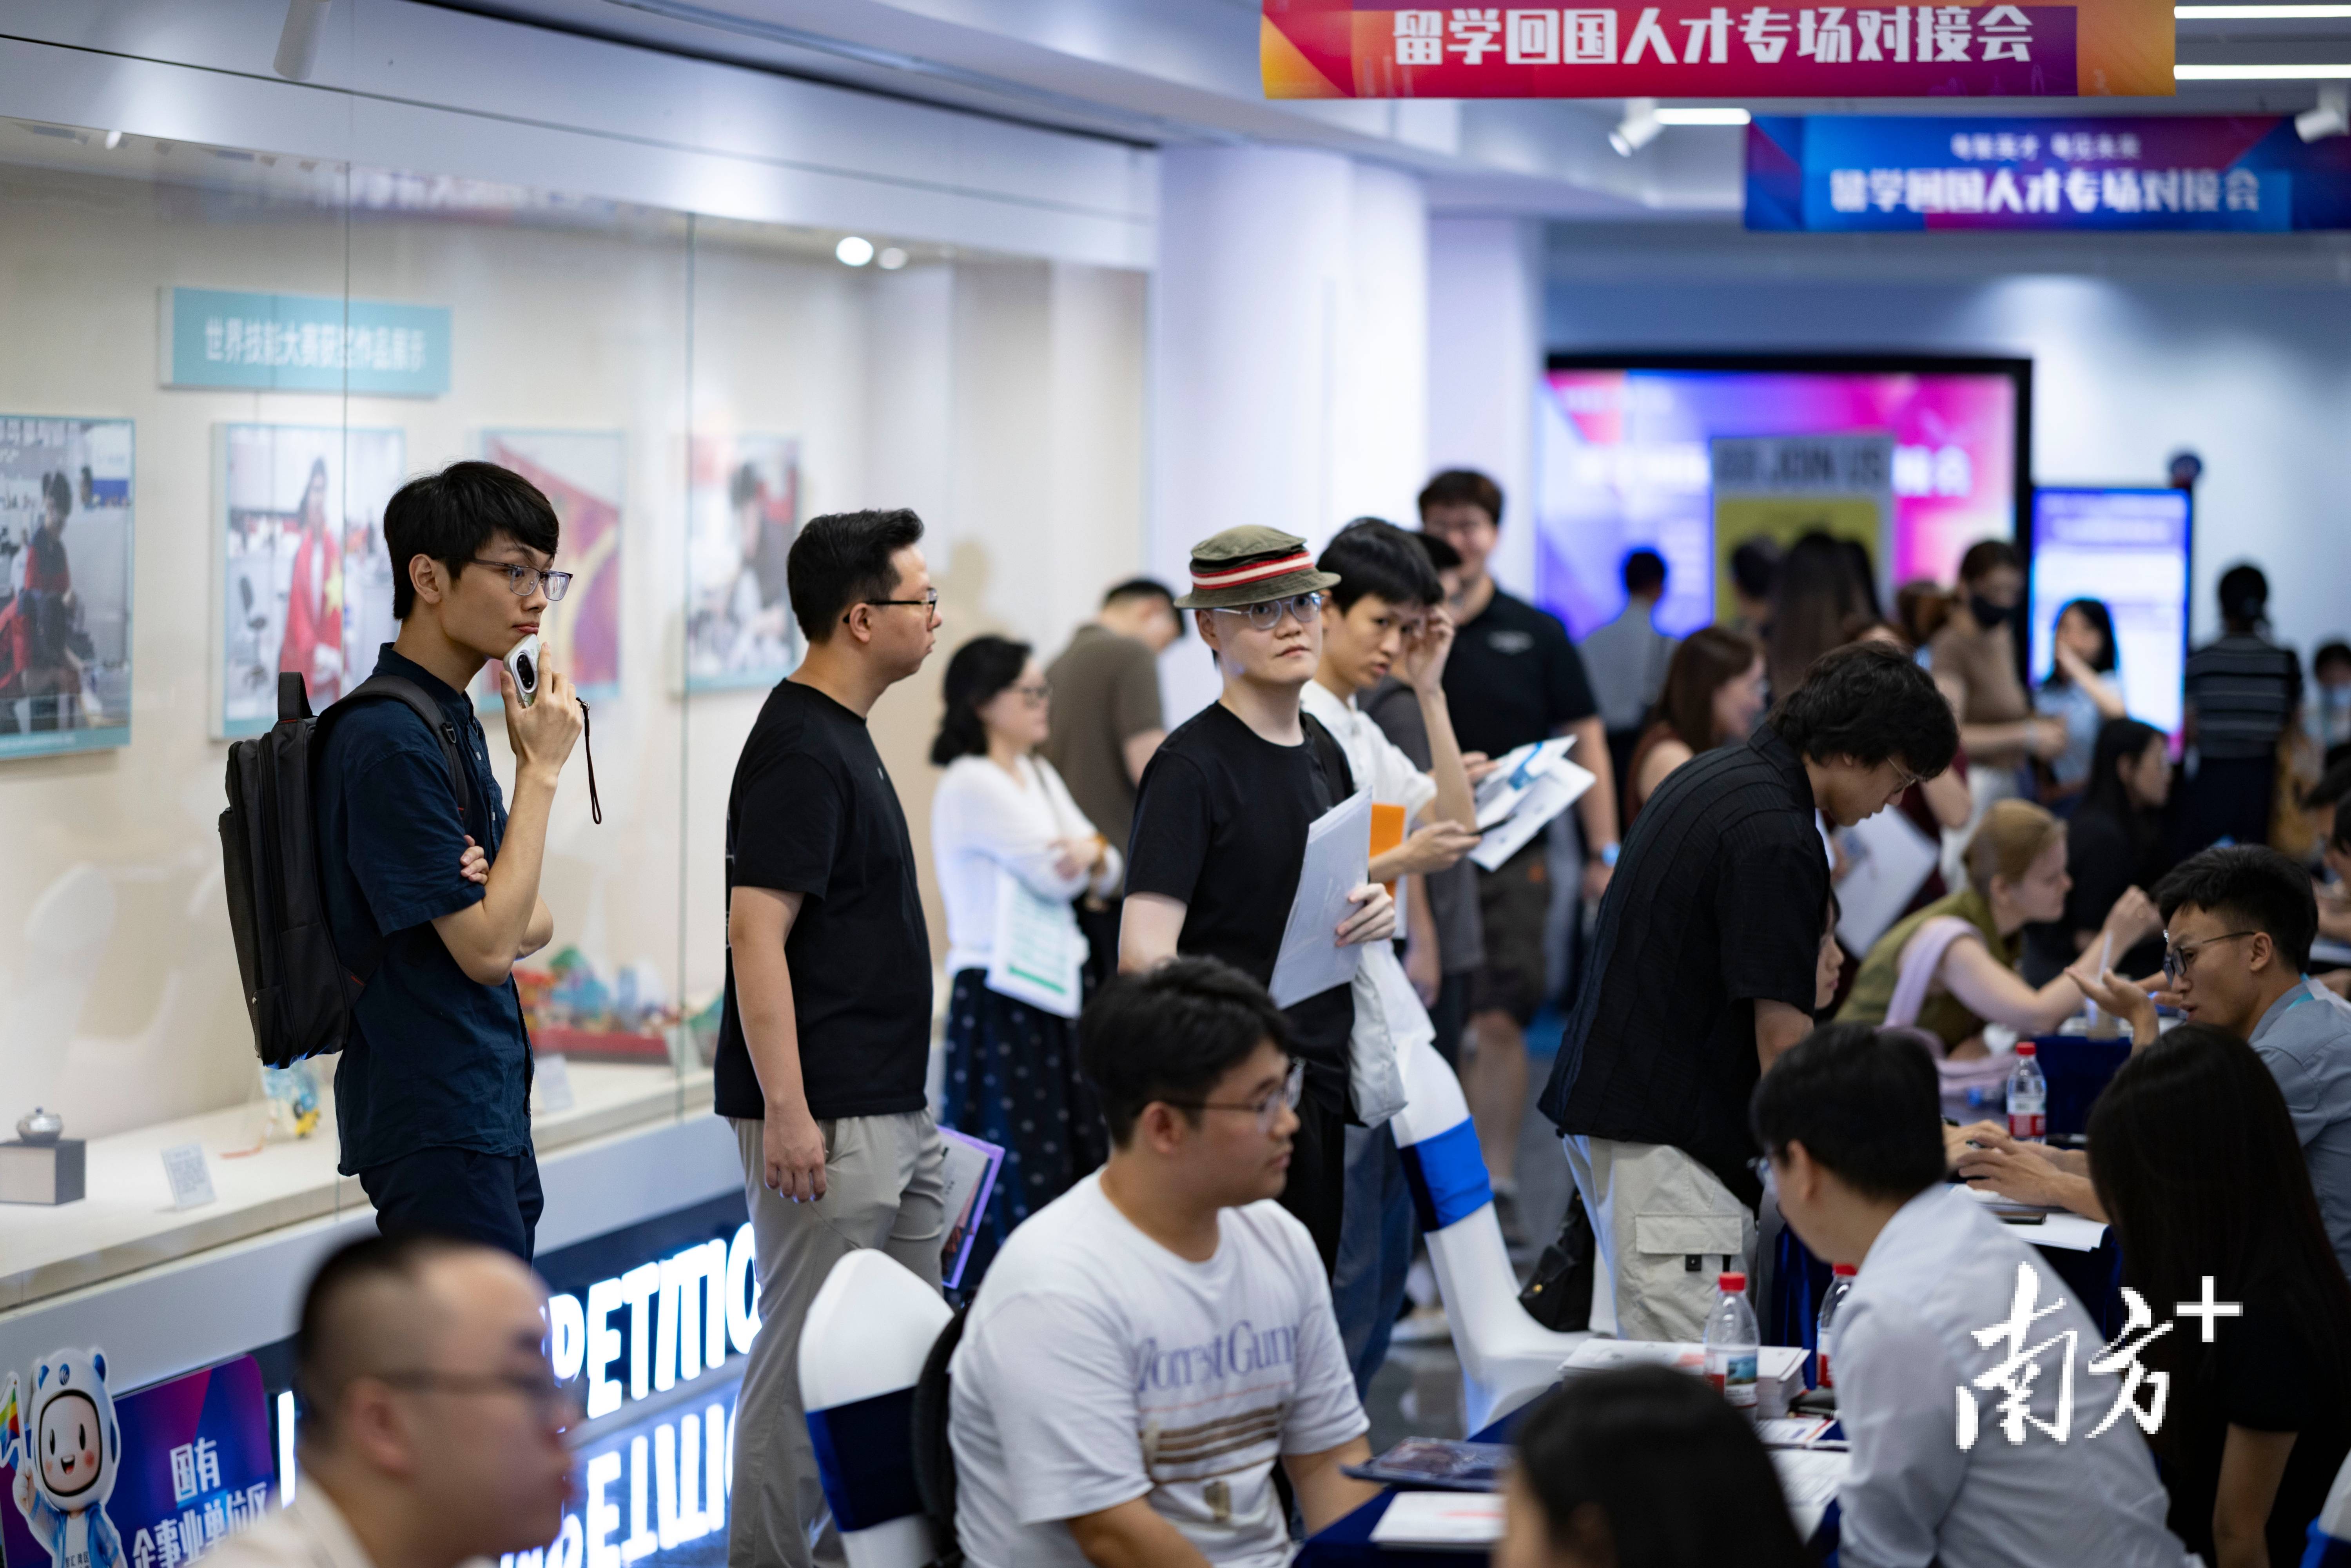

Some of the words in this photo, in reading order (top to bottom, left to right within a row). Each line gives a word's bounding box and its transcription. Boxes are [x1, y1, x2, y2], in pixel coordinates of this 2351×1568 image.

[1393, 5, 2034, 64] 留学回国人才专场对接会
[169, 1436, 221, 1503] 国有
